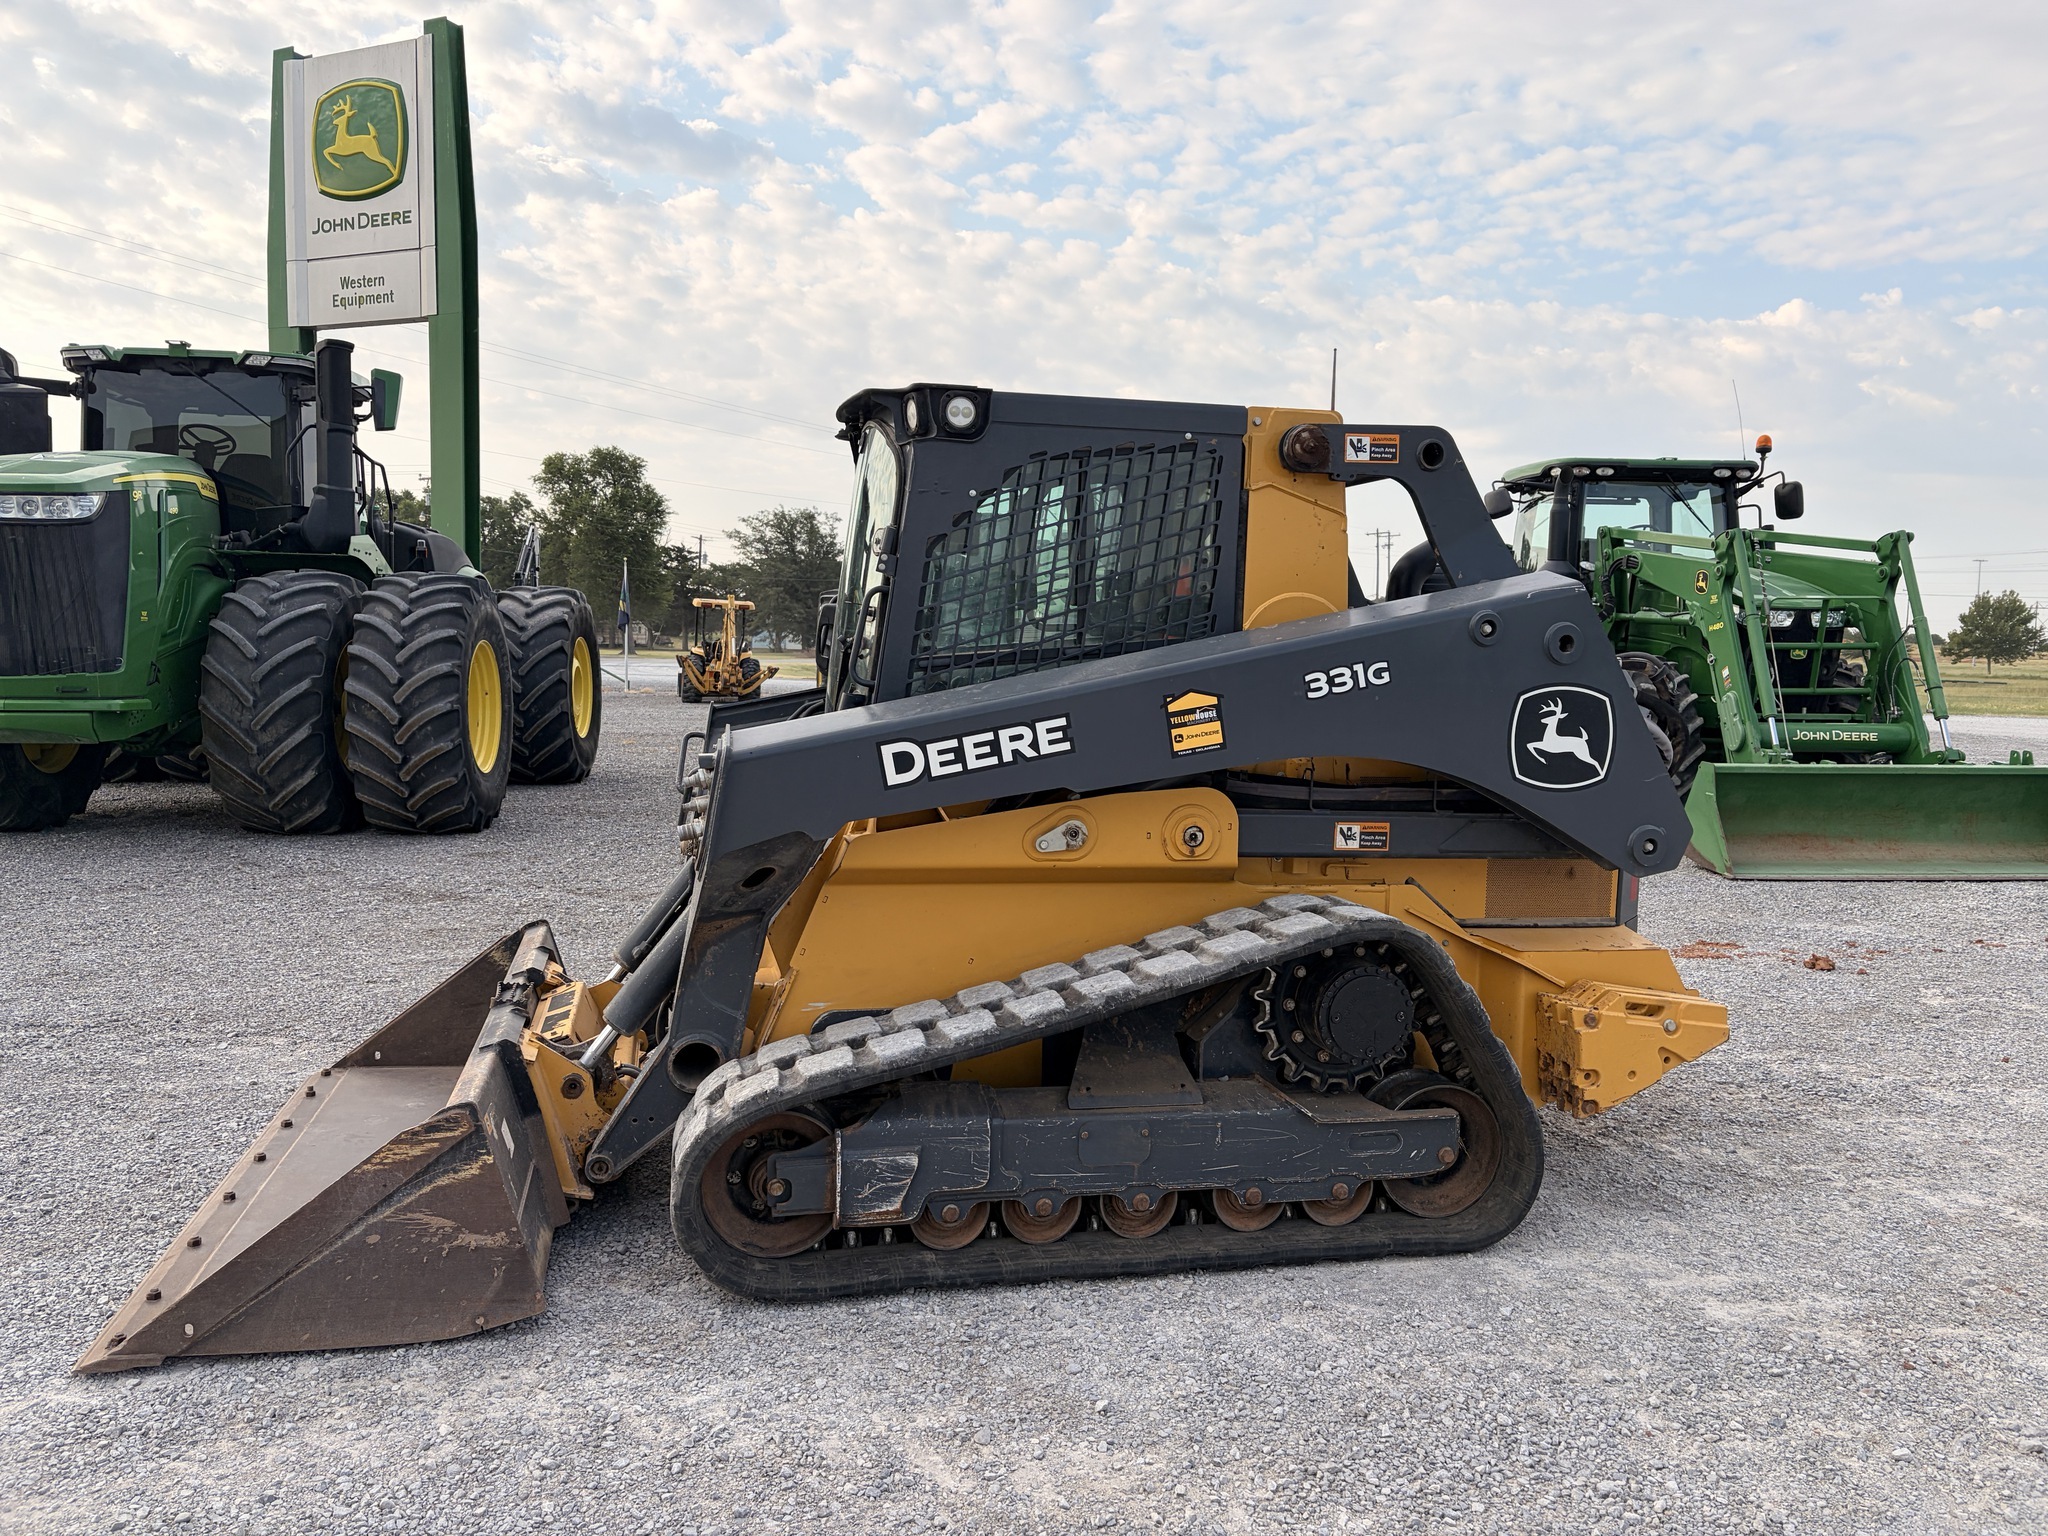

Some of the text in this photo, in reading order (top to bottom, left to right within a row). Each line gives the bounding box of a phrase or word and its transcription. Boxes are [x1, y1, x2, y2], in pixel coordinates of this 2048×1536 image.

[312, 210, 412, 235] JOHN DEERE
[340, 275, 385, 290] Western
[332, 290, 395, 310] Equipment
[132, 490, 143, 502] 9R
[1708, 621, 1724, 632] H480
[1304, 661, 1391, 699] 331G
[1170, 709, 1218, 725] YELLOWHOUSE
[1200, 729, 1220, 738] DEERE
[1793, 729, 1879, 742] JOHN DEERE
[880, 717, 1072, 787] DEERE
